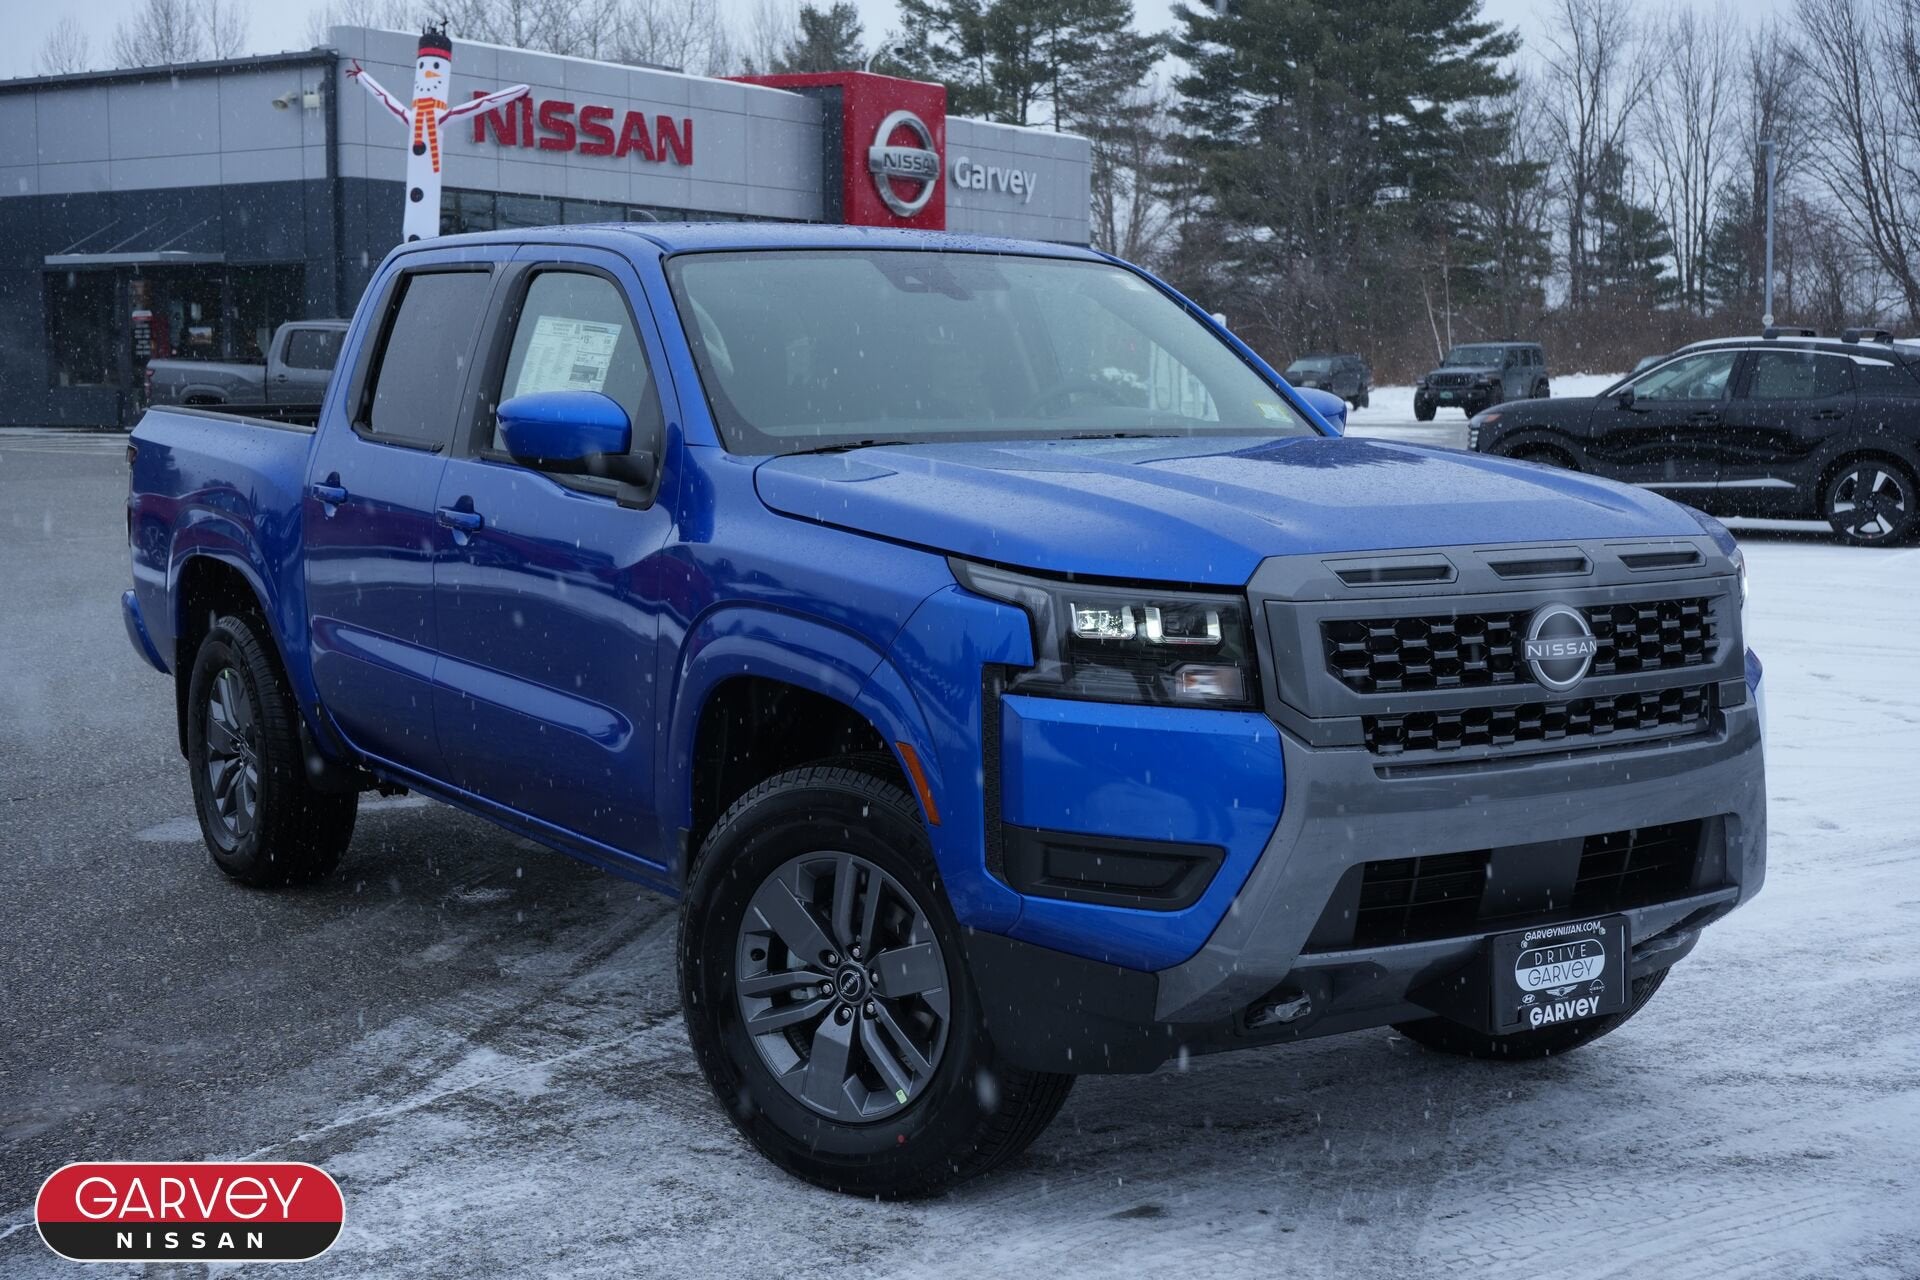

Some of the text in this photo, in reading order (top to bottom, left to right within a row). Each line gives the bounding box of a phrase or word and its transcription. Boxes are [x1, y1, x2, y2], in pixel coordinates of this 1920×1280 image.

[473, 91, 693, 166] NISSAN
[954, 156, 1037, 204] Garvey
[1528, 640, 1597, 656] NISSAN
[1534, 944, 1587, 965] DRIVE
